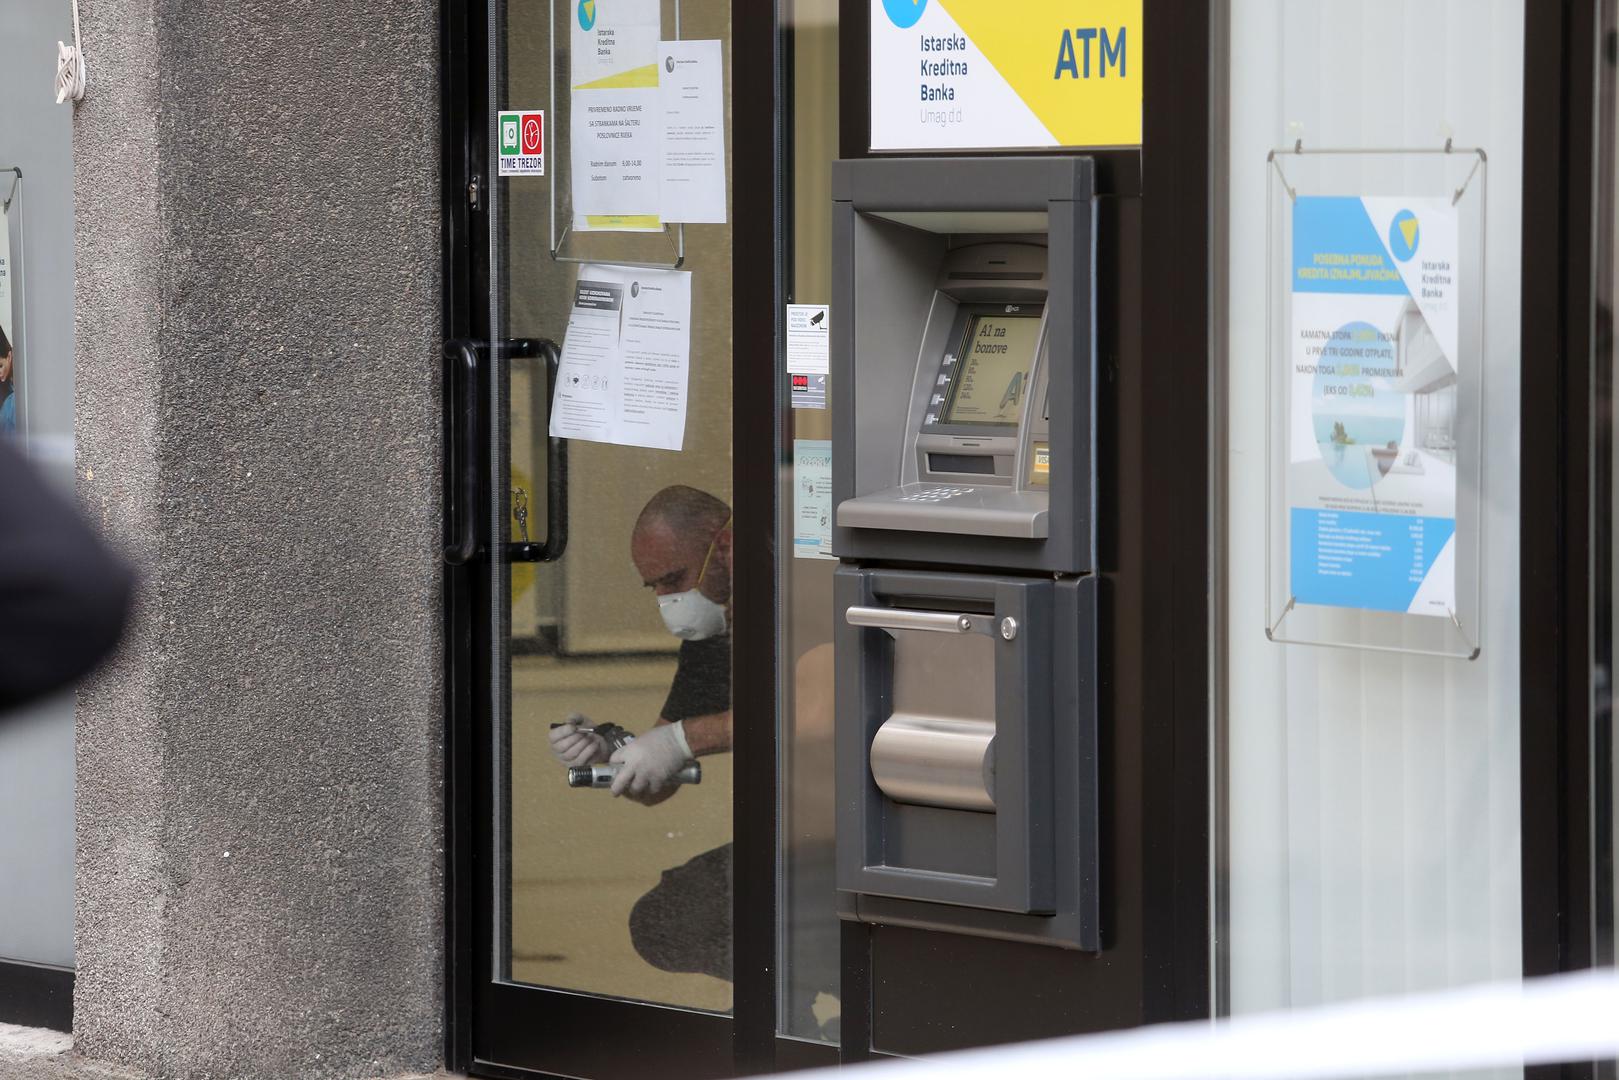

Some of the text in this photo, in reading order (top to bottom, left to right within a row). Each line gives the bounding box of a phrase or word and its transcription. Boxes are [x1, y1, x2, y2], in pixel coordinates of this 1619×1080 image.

[920, 33, 966, 52] Istarska
[598, 47, 611, 55] Banka
[1054, 27, 1127, 80] ATM
[920, 59, 968, 77] Kreditna
[920, 84, 955, 102] Banka
[920, 109, 946, 128] Umag
[501, 157, 542, 169] TIME TREZOR
[1421, 261, 1450, 271] Istarska
[1421, 274, 1451, 284] Kreditna
[1421, 287, 1443, 298] Banka
[994, 327, 1006, 337] na
[1300, 329, 1330, 340] KAMATNA
[1330, 331, 1351, 340] STOPA
[974, 341, 1008, 355] bonove
[1312, 346, 1327, 356] PRVE
[1328, 347, 1338, 357] TRI
[1339, 347, 1364, 358] GODINE
[1296, 364, 1317, 375] NAKON
[1318, 365, 1335, 375] TOGA
